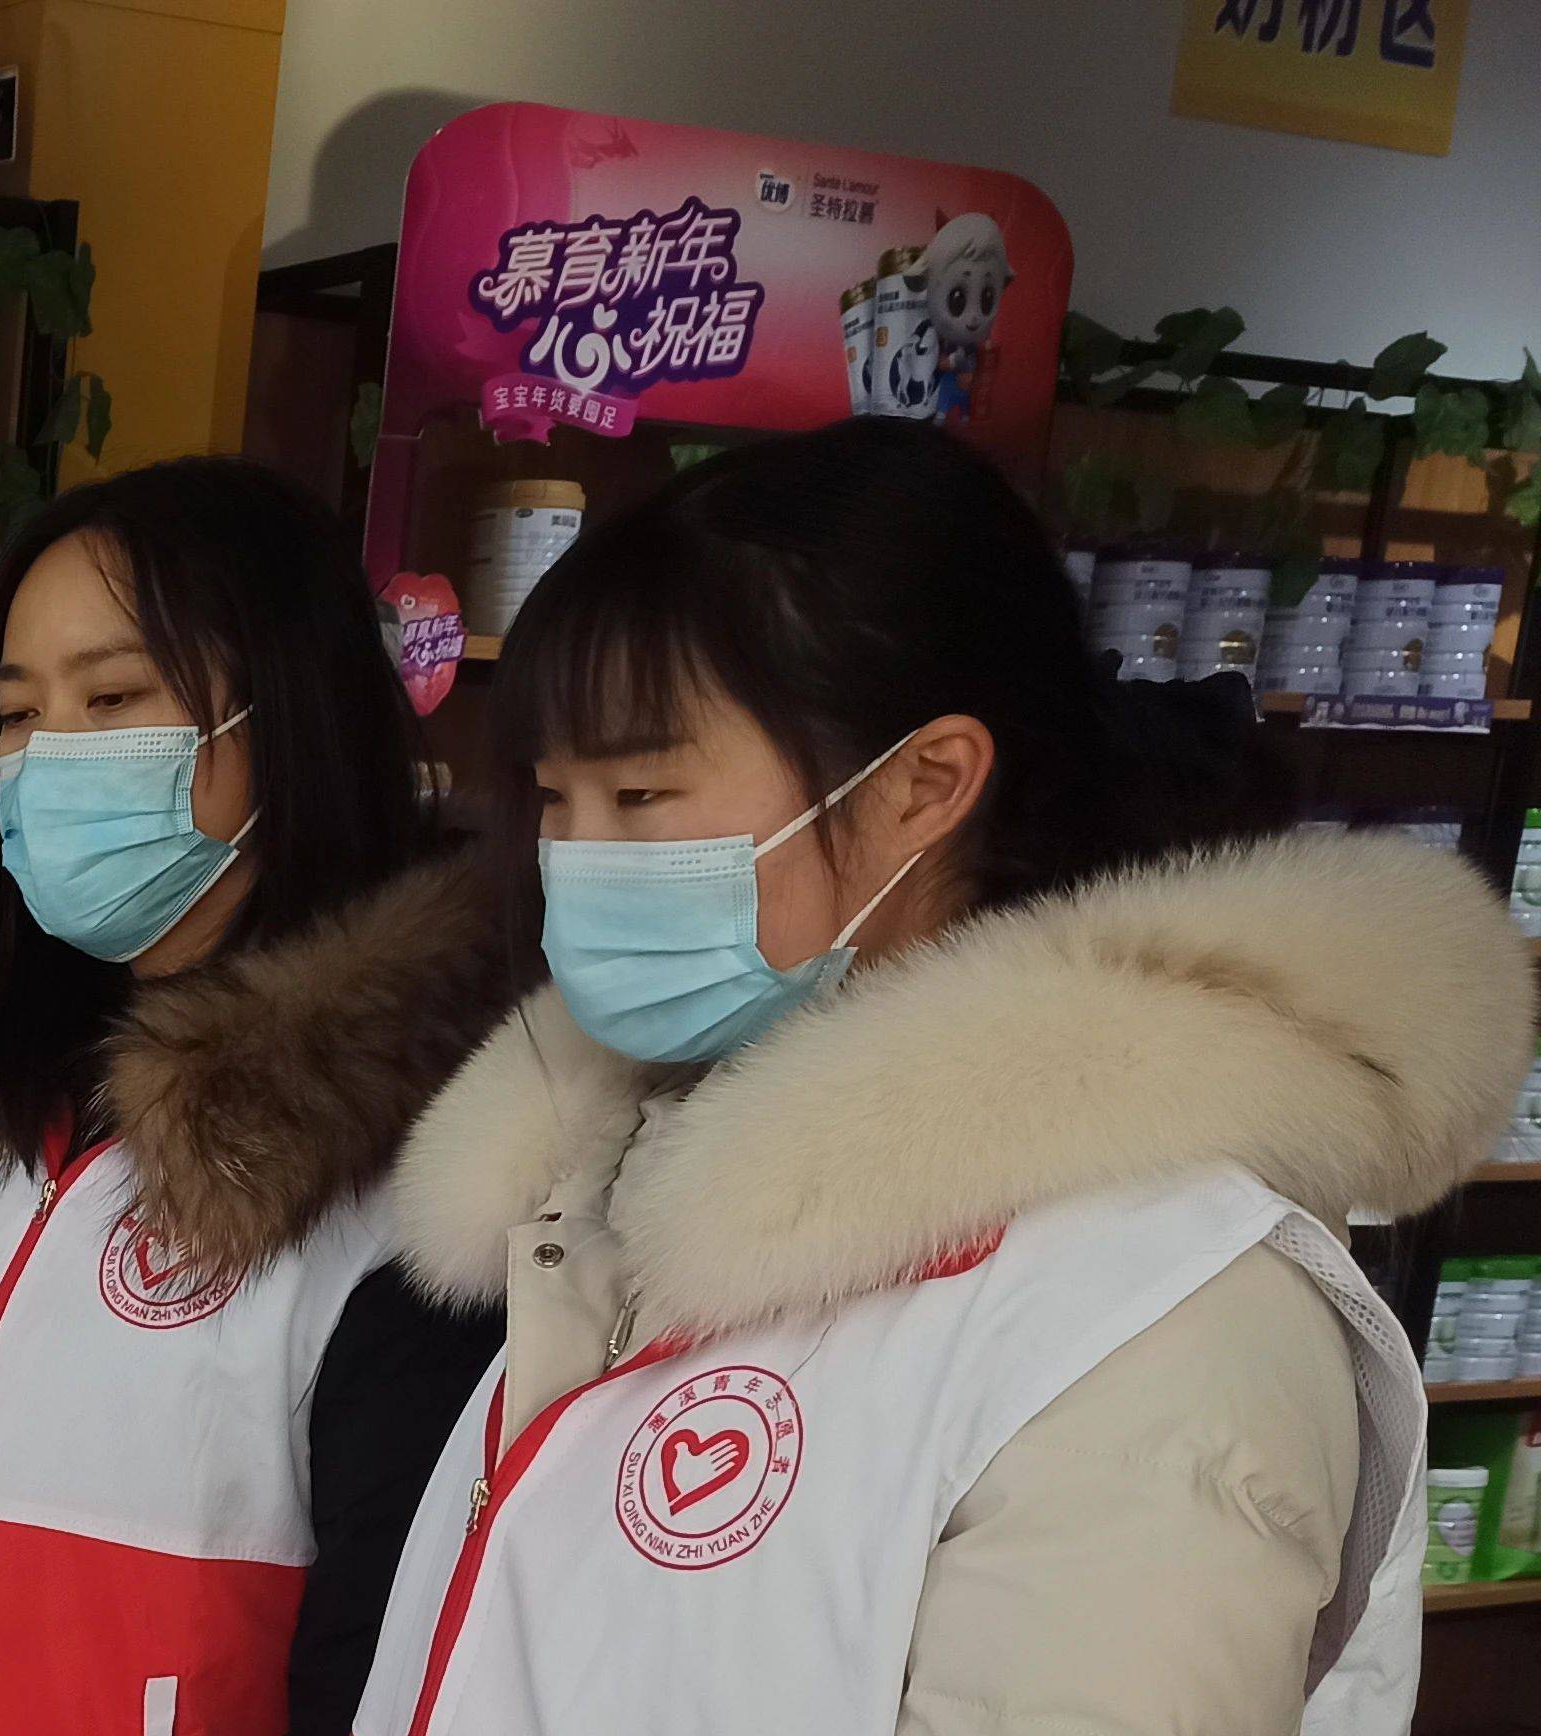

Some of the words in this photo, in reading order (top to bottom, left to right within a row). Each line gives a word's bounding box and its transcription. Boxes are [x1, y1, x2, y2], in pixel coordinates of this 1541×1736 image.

[121, 1300, 149, 1320] NIAN
[150, 1310, 171, 1321] ZHI
[173, 1297, 211, 1318] YUAN
[625, 1451, 642, 1477] SUI
[622, 1481, 635, 1497] XI
[623, 1499, 648, 1537] QING
[749, 1495, 777, 1531] ZHE
[645, 1532, 673, 1559] NIAN
[675, 1544, 703, 1559] ZHI
[706, 1526, 751, 1555] YUAN
